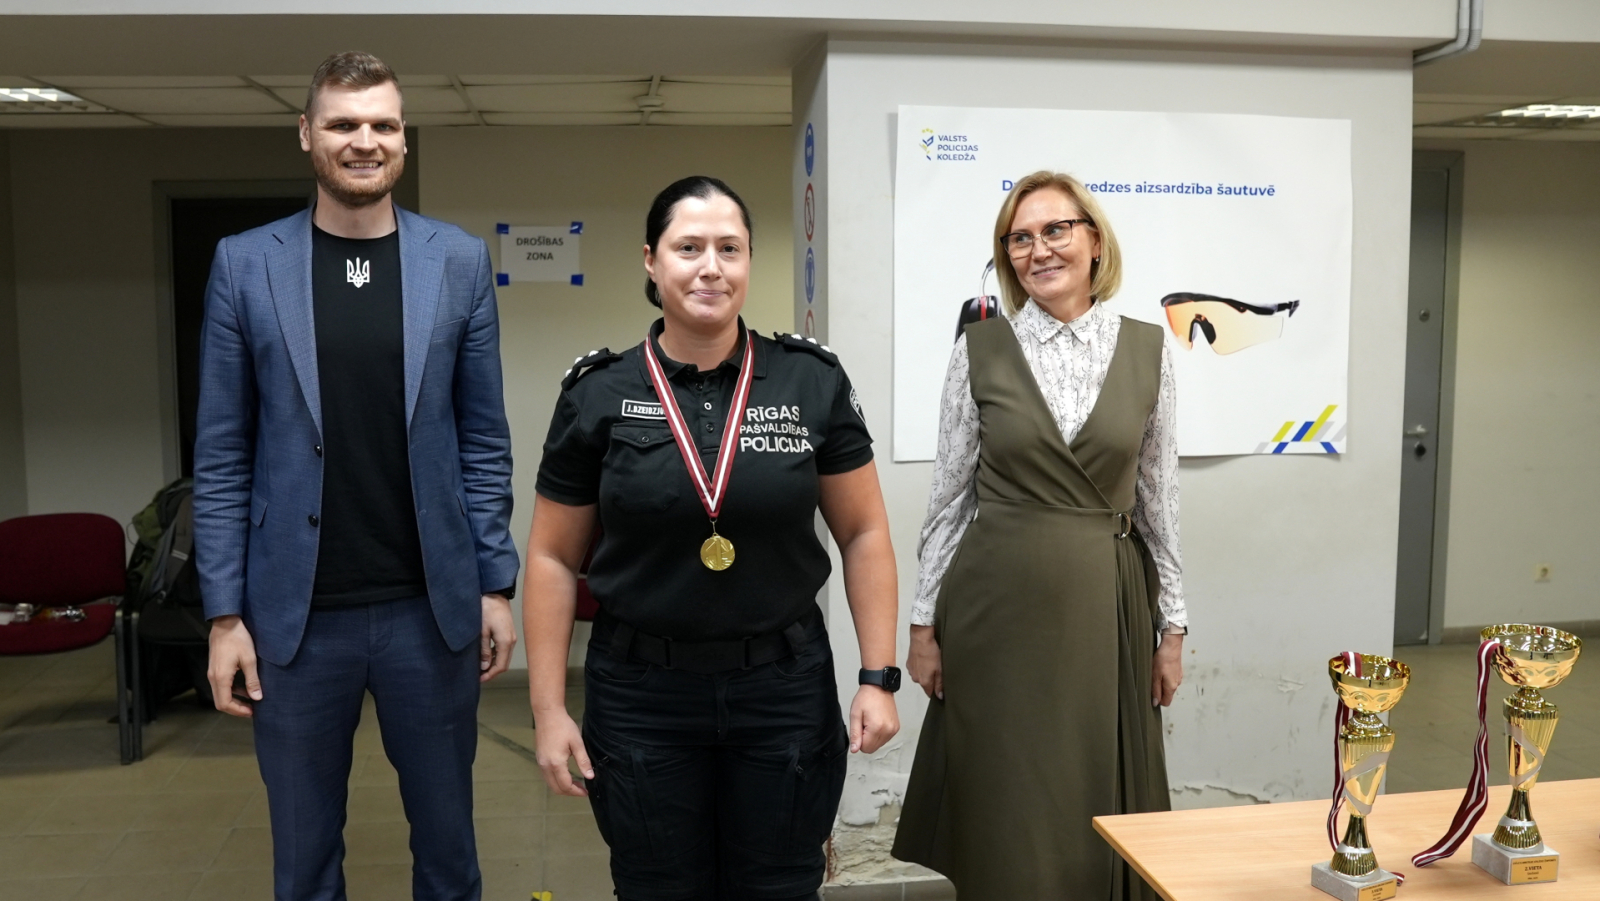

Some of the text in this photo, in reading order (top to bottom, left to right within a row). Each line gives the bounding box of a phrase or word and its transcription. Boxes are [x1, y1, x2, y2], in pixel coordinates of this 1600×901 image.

[937, 144, 979, 152] POLICIJAS
[937, 153, 977, 161] KOLEDŽA
[1135, 181, 1213, 195] aizsardzība
[1217, 183, 1275, 197] šautuvē
[516, 235, 564, 246] DROŠĪBAS
[526, 252, 554, 261] ZONA
[746, 405, 800, 422] RĪGAS
[740, 422, 809, 437] PAŠVALDĪBAS
[740, 435, 814, 453] POLICIJA
